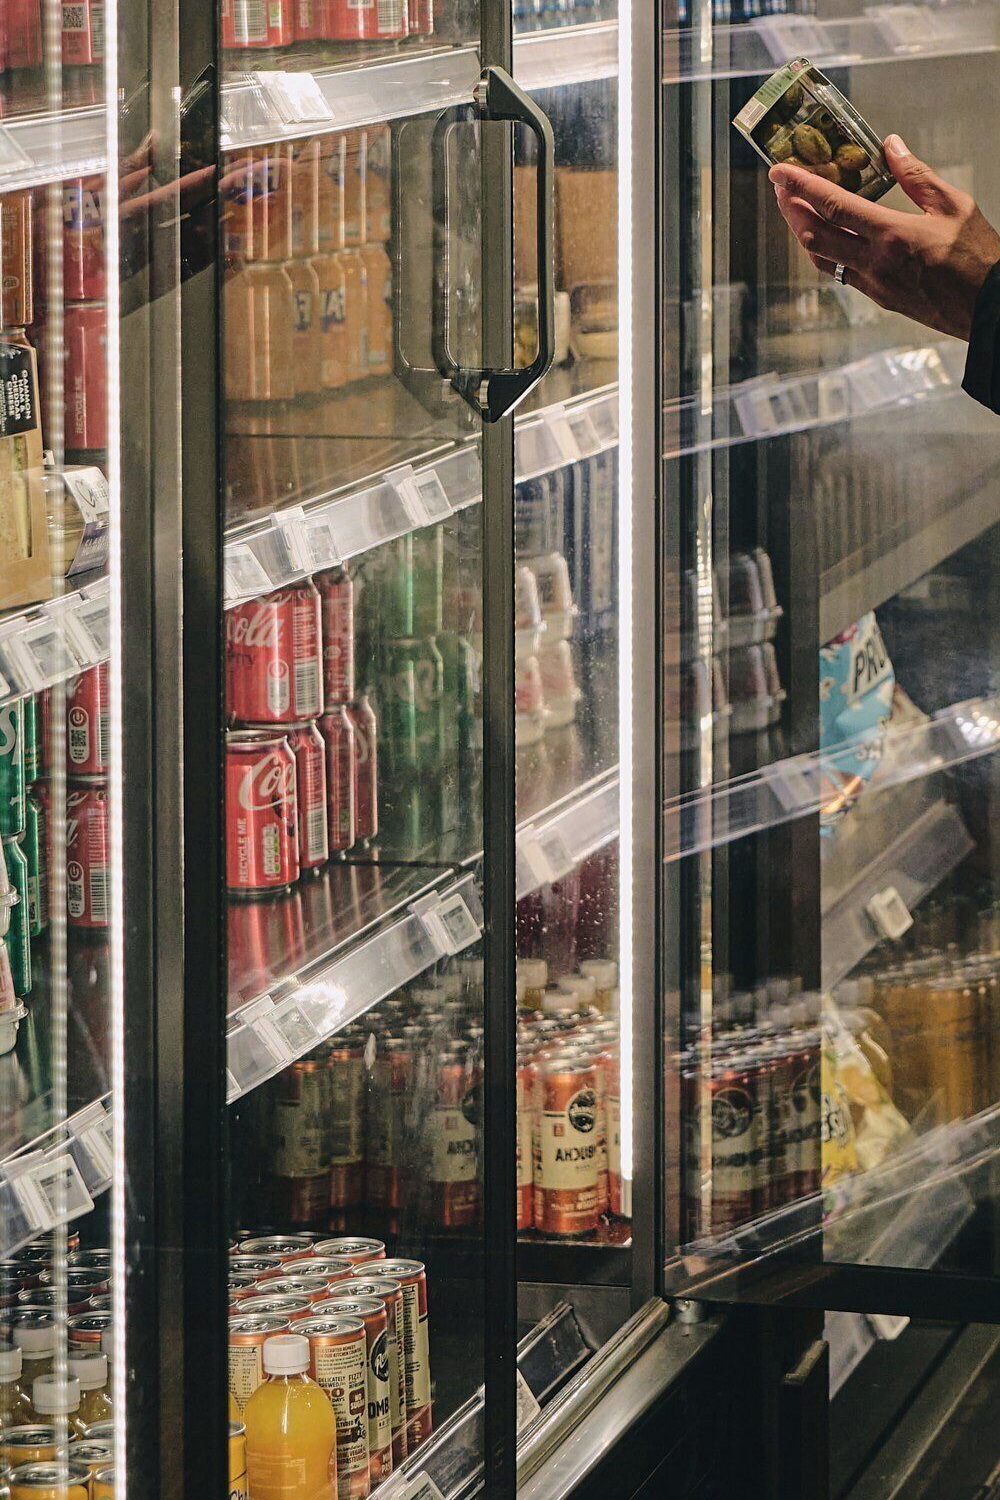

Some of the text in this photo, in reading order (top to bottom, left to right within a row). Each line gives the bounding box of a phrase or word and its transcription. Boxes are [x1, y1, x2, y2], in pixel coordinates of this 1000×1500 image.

[6, 380, 15, 417] CHEESE
[11, 373, 22, 421] CHEDDAR
[21, 369, 32, 420] GAMMON
[226, 593, 292, 648] ola
[236, 817, 249, 884] RECYCLE ME
[318, 1375, 346, 1383] DELICATELY
[348, 1371, 362, 1381] FIZZY
